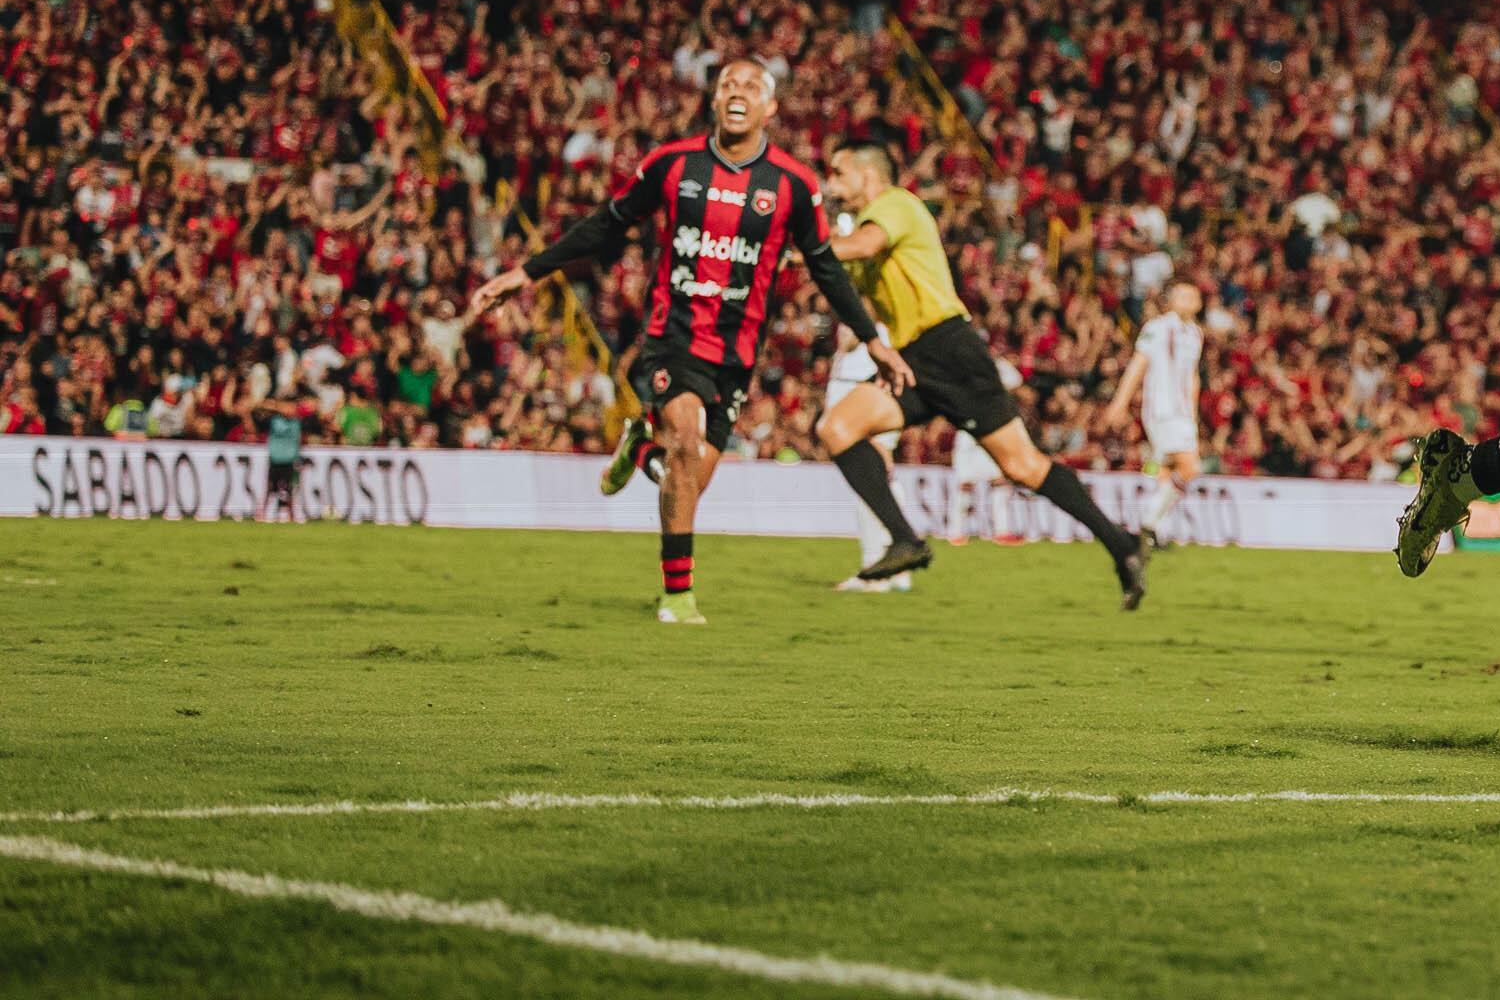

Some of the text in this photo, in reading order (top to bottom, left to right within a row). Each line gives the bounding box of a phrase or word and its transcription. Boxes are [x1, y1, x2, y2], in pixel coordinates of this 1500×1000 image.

[699, 230, 761, 266] kölbi
[33, 447, 200, 519] SABADO
[214, 455, 257, 520] 23
